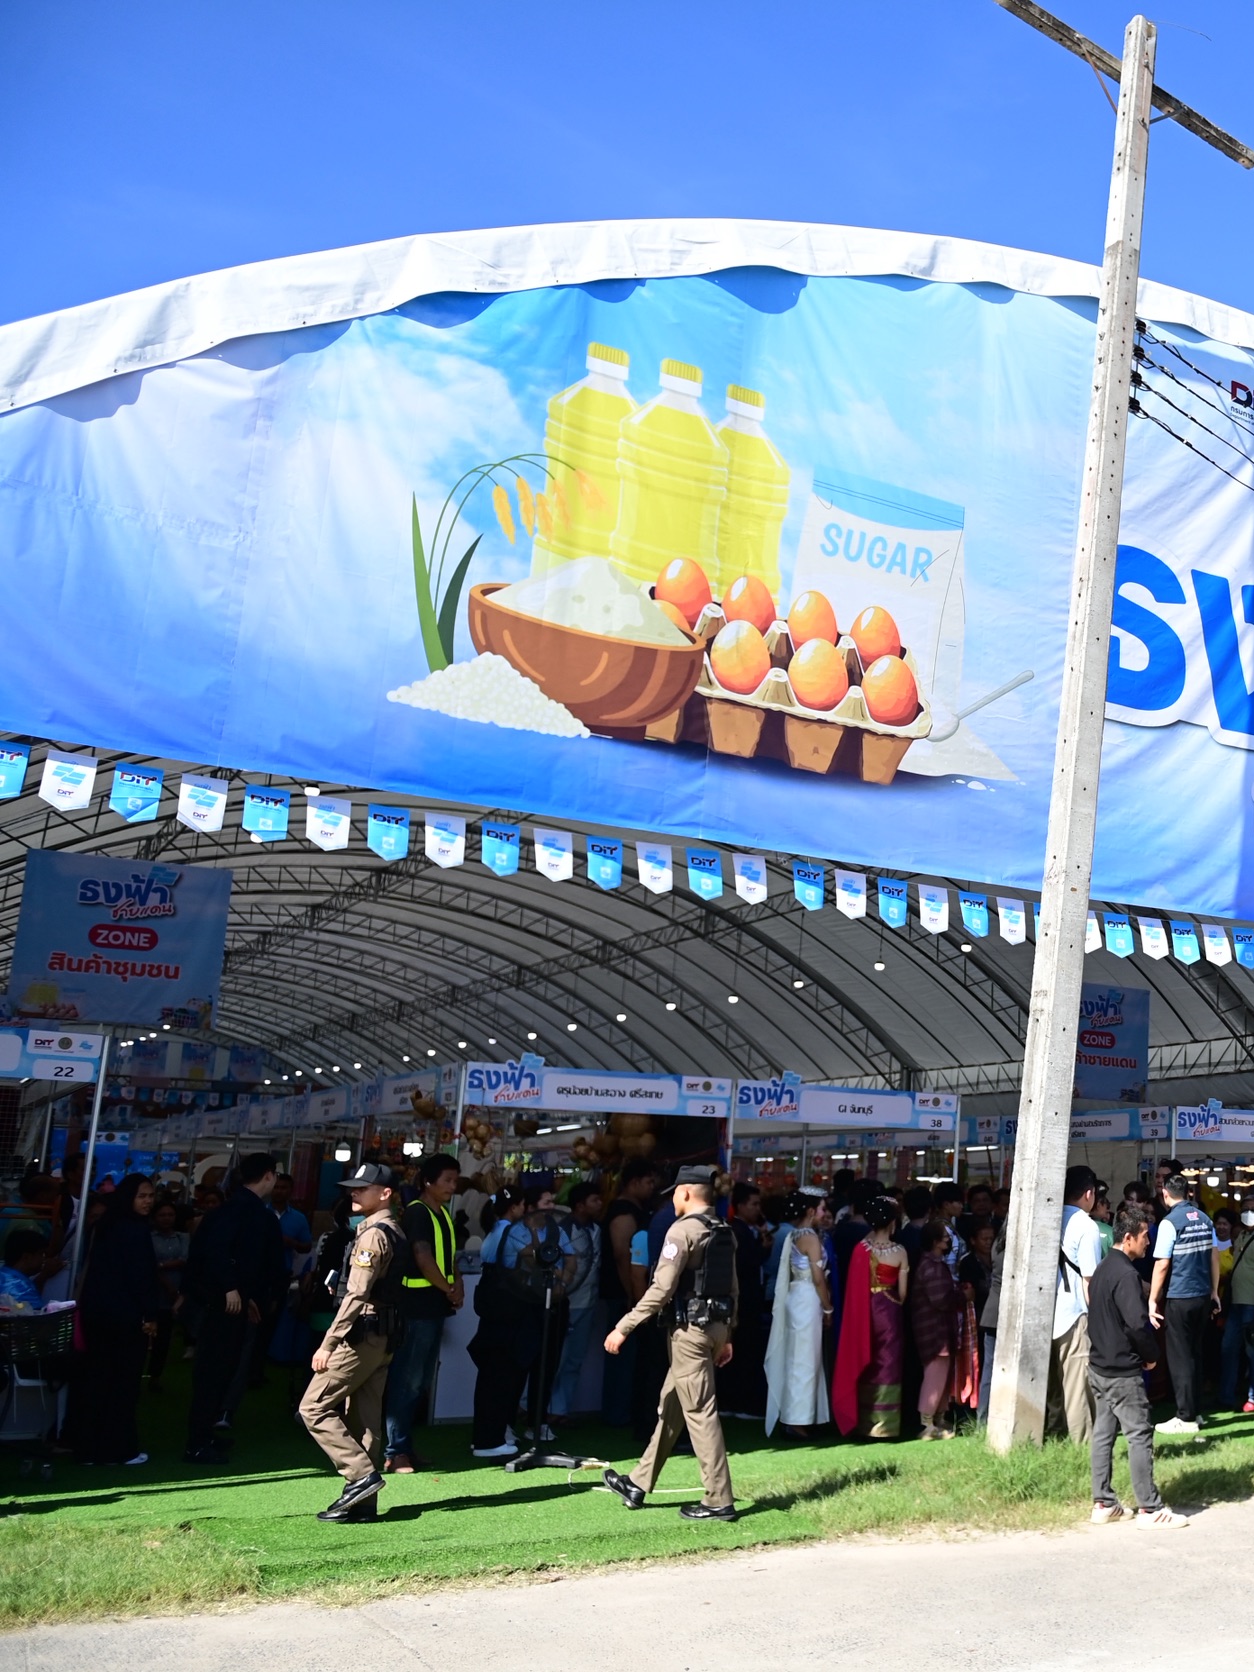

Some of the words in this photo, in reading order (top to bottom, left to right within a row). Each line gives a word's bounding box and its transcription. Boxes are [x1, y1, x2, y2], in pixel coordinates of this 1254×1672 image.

[820, 523, 933, 583] SUGAR
[79, 874, 170, 906] ธงฟ้า
[113, 900, 173, 919] ชายแดน
[95, 930, 151, 947] ZONE
[48, 952, 180, 982] สินค้าชุมชน
[1080, 995, 1118, 1017] งฟ้า
[1083, 1034, 1112, 1046] ZONE
[1076, 1050, 1137, 1069] ค้าชายแดน
[54, 1066, 75, 1077] 22
[468, 1062, 536, 1091] ธงฟ้า
[494, 1084, 540, 1103] ชายแดน
[738, 1080, 795, 1106] ธงฟ้า
[702, 1105, 716, 1115] 23
[759, 1101, 797, 1117] ชายแดน
[838, 1104, 847, 1113] GI
[1178, 1106, 1217, 1129] ธงฟ้า
[930, 1119, 942, 1128] 38
[1193, 1123, 1220, 1138] ชายแดน
